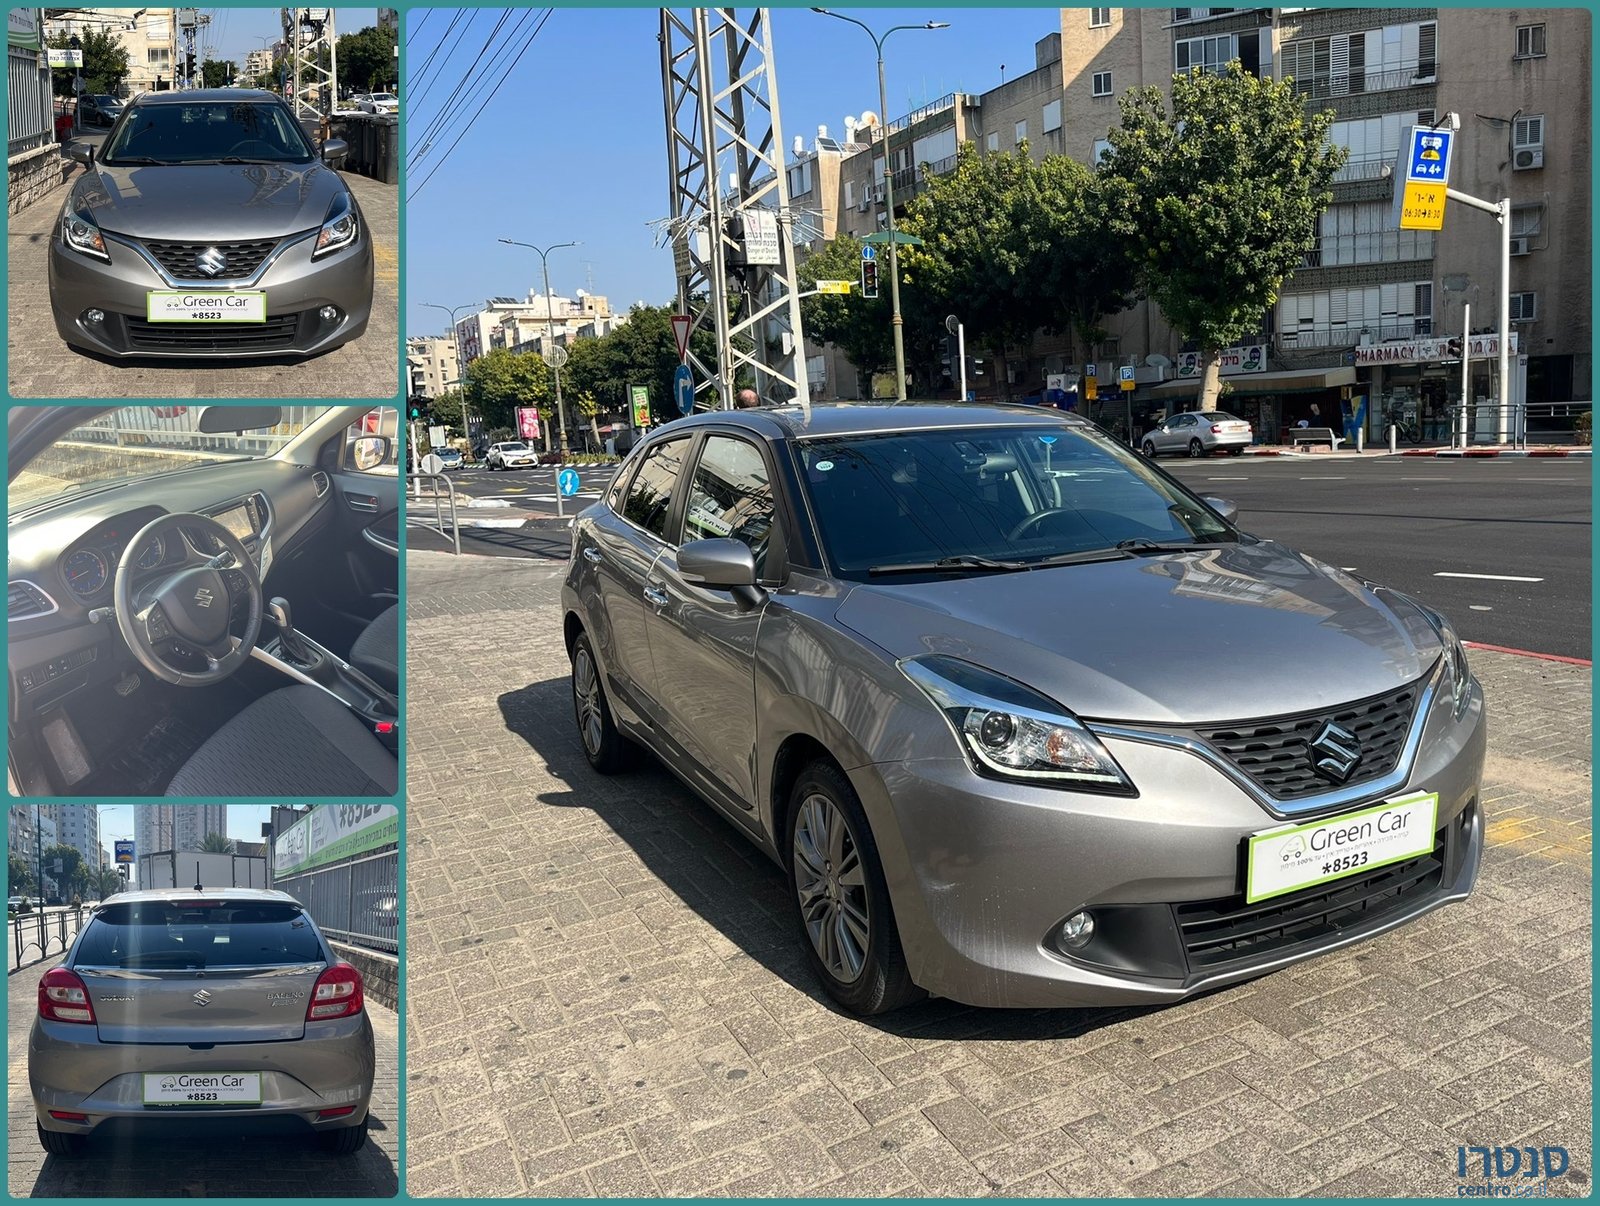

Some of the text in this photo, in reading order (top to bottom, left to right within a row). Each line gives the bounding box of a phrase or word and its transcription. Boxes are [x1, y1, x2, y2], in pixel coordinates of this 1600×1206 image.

[1428, 163, 1441, 175] 4+
[183, 296, 248, 307] Green Car
[1355, 346, 1415, 362] PHARMACY
[1310, 811, 1411, 851] Green Car
[267, 991, 305, 1000] BALENO
[179, 1075, 245, 1087] Green Car
